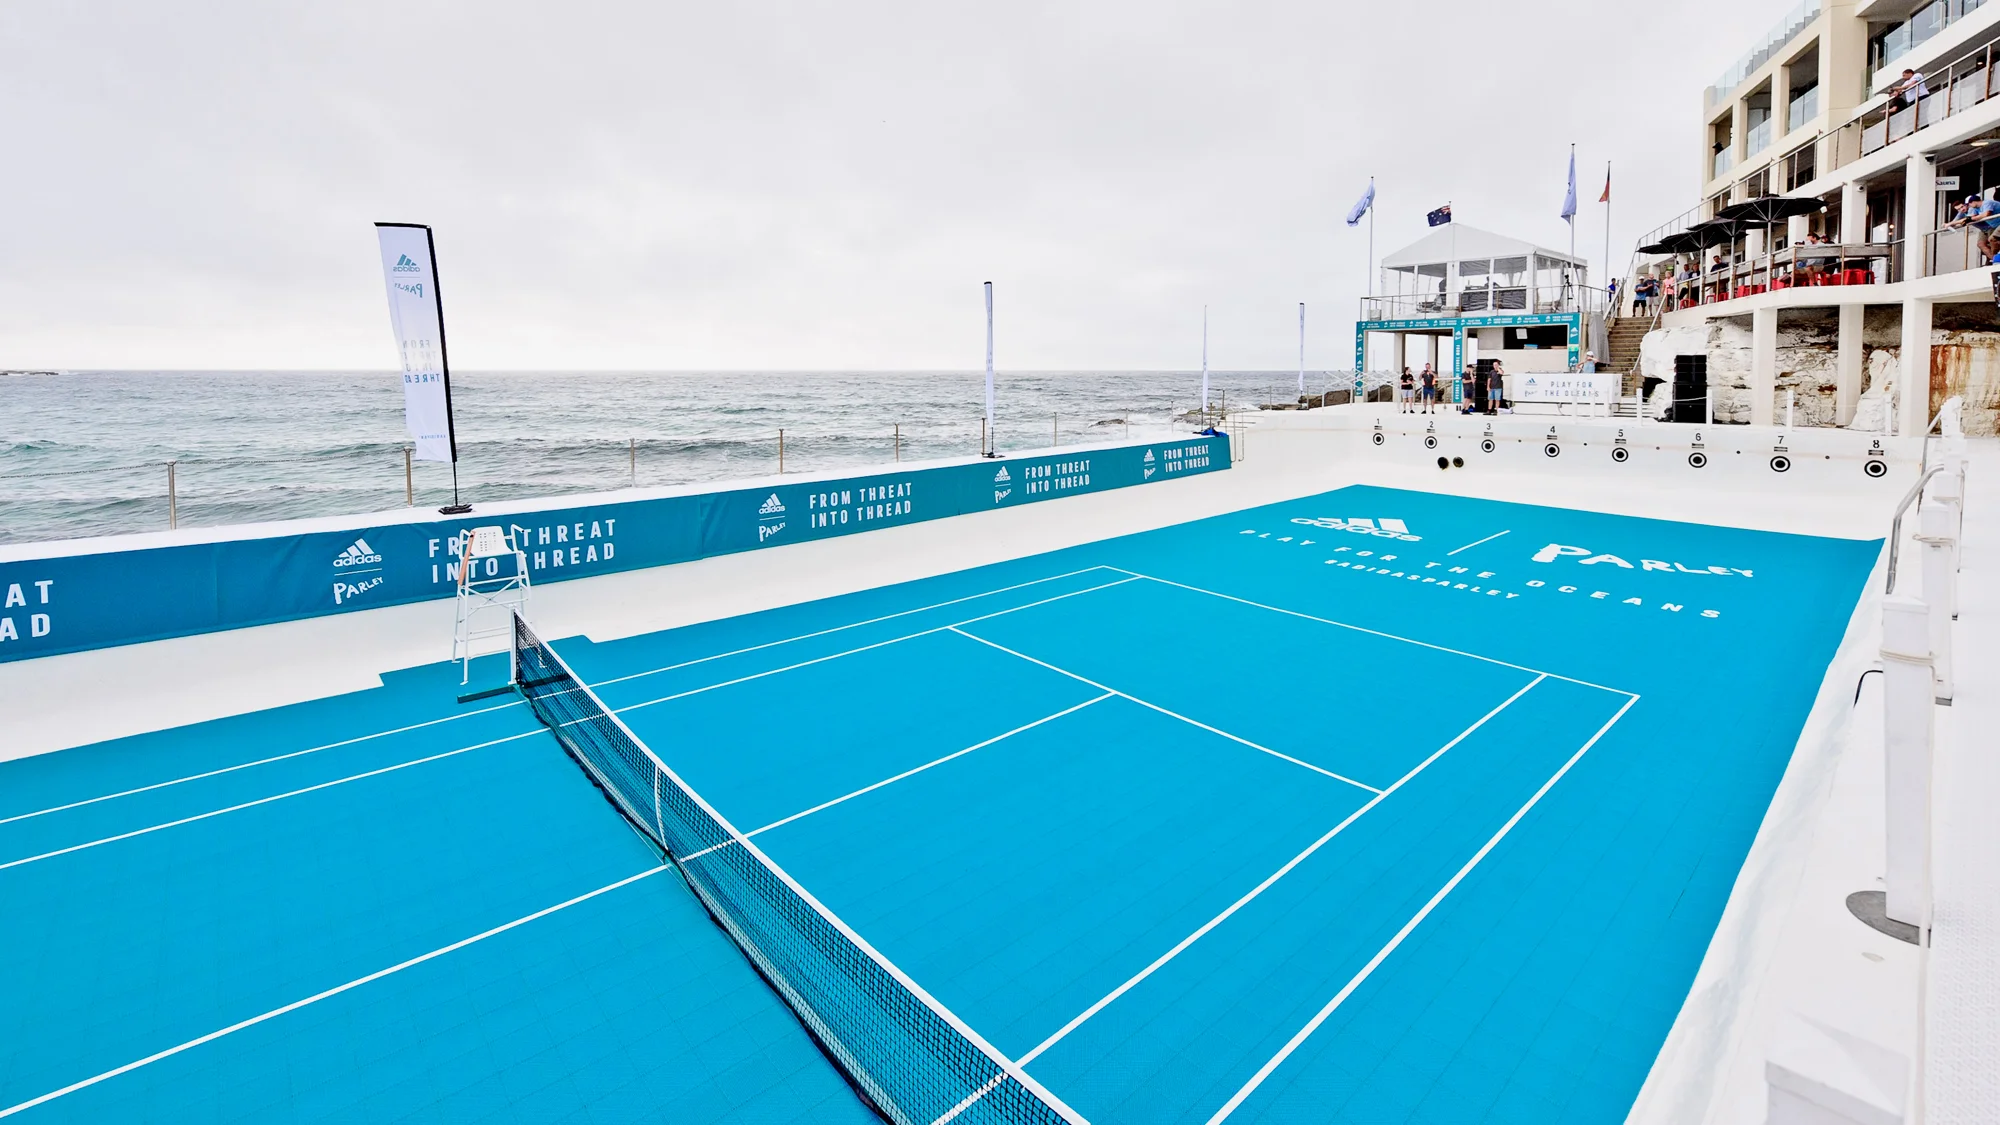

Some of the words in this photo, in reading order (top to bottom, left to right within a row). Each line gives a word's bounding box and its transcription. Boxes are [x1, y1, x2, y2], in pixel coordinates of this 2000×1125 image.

[1544, 389, 1560, 397] THE
[1550, 426, 1556, 434] 4
[1618, 429, 1624, 437] 5
[1695, 433, 1701, 441] 6
[1777, 435, 1784, 444] 7
[1163, 448, 1183, 460] FROM
[1185, 444, 1209, 457] THREAT
[1872, 440, 1880, 448] 8
[1025, 465, 1051, 479] FROM
[1056, 460, 1090, 475] THREAT
[1165, 460, 1182, 473] INTO
[1184, 456, 1210, 469] THREAD
[1026, 480, 1050, 494] INTO
[1054, 474, 1090, 490] THREAD
[809, 490, 851, 509] FROM
[859, 482, 912, 502] THREAT
[758, 505, 786, 515] adidas
[811, 509, 848, 528] INTO
[856, 500, 911, 521] THREAD
[522, 519, 616, 547] THREAT
[758, 522, 786, 542] PARLEY
[1290, 517, 1423, 542] adidas
[333, 553, 382, 567] adidas
[524, 542, 614, 570] HREAD
[1531, 543, 1754, 577] PARLEY
[1239, 529, 1316, 546] PLAY
[1333, 546, 1398, 561] FOR
[1425, 561, 1496, 578] THE
[1525, 580, 1721, 618] OCEANS
[333, 576, 384, 605] PARLEY
